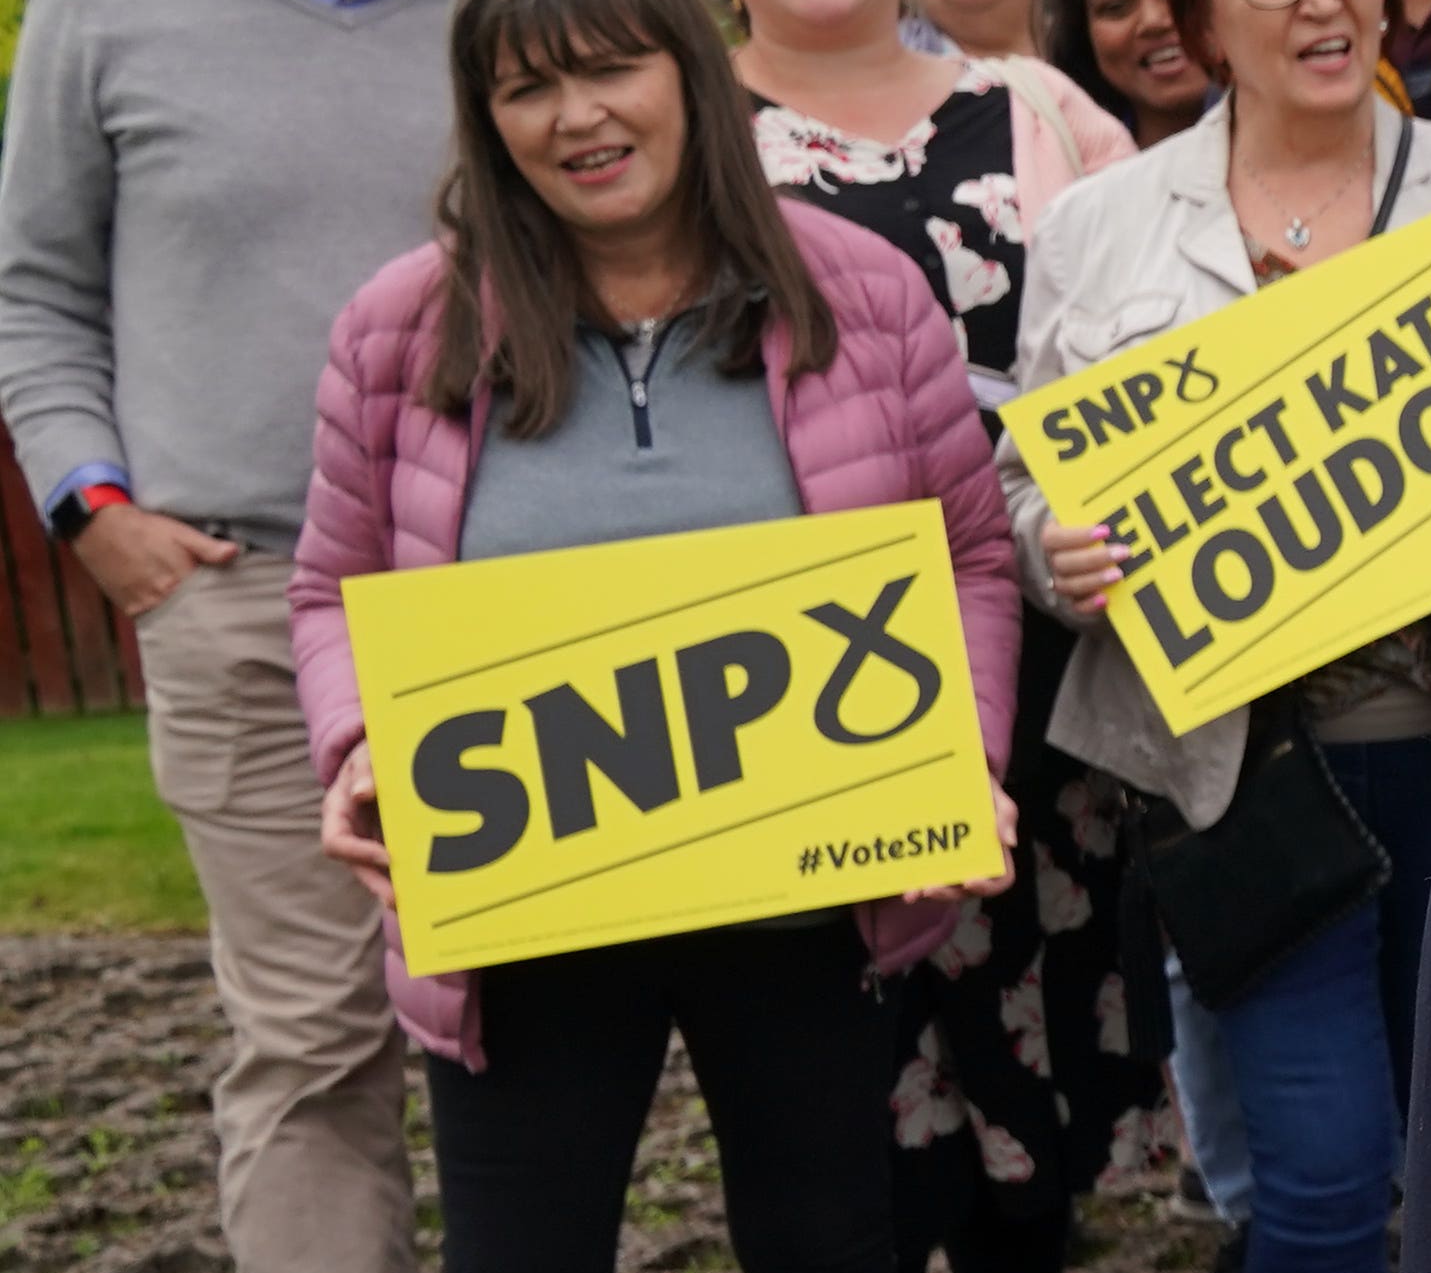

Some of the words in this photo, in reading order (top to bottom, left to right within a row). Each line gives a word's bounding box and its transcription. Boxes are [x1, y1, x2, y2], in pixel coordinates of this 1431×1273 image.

[1041, 370, 1164, 462] SNP
[1099, 397, 1299, 579] ELECT
[411, 629, 791, 874] SNP
[798, 822, 971, 874] #VoteSNP
